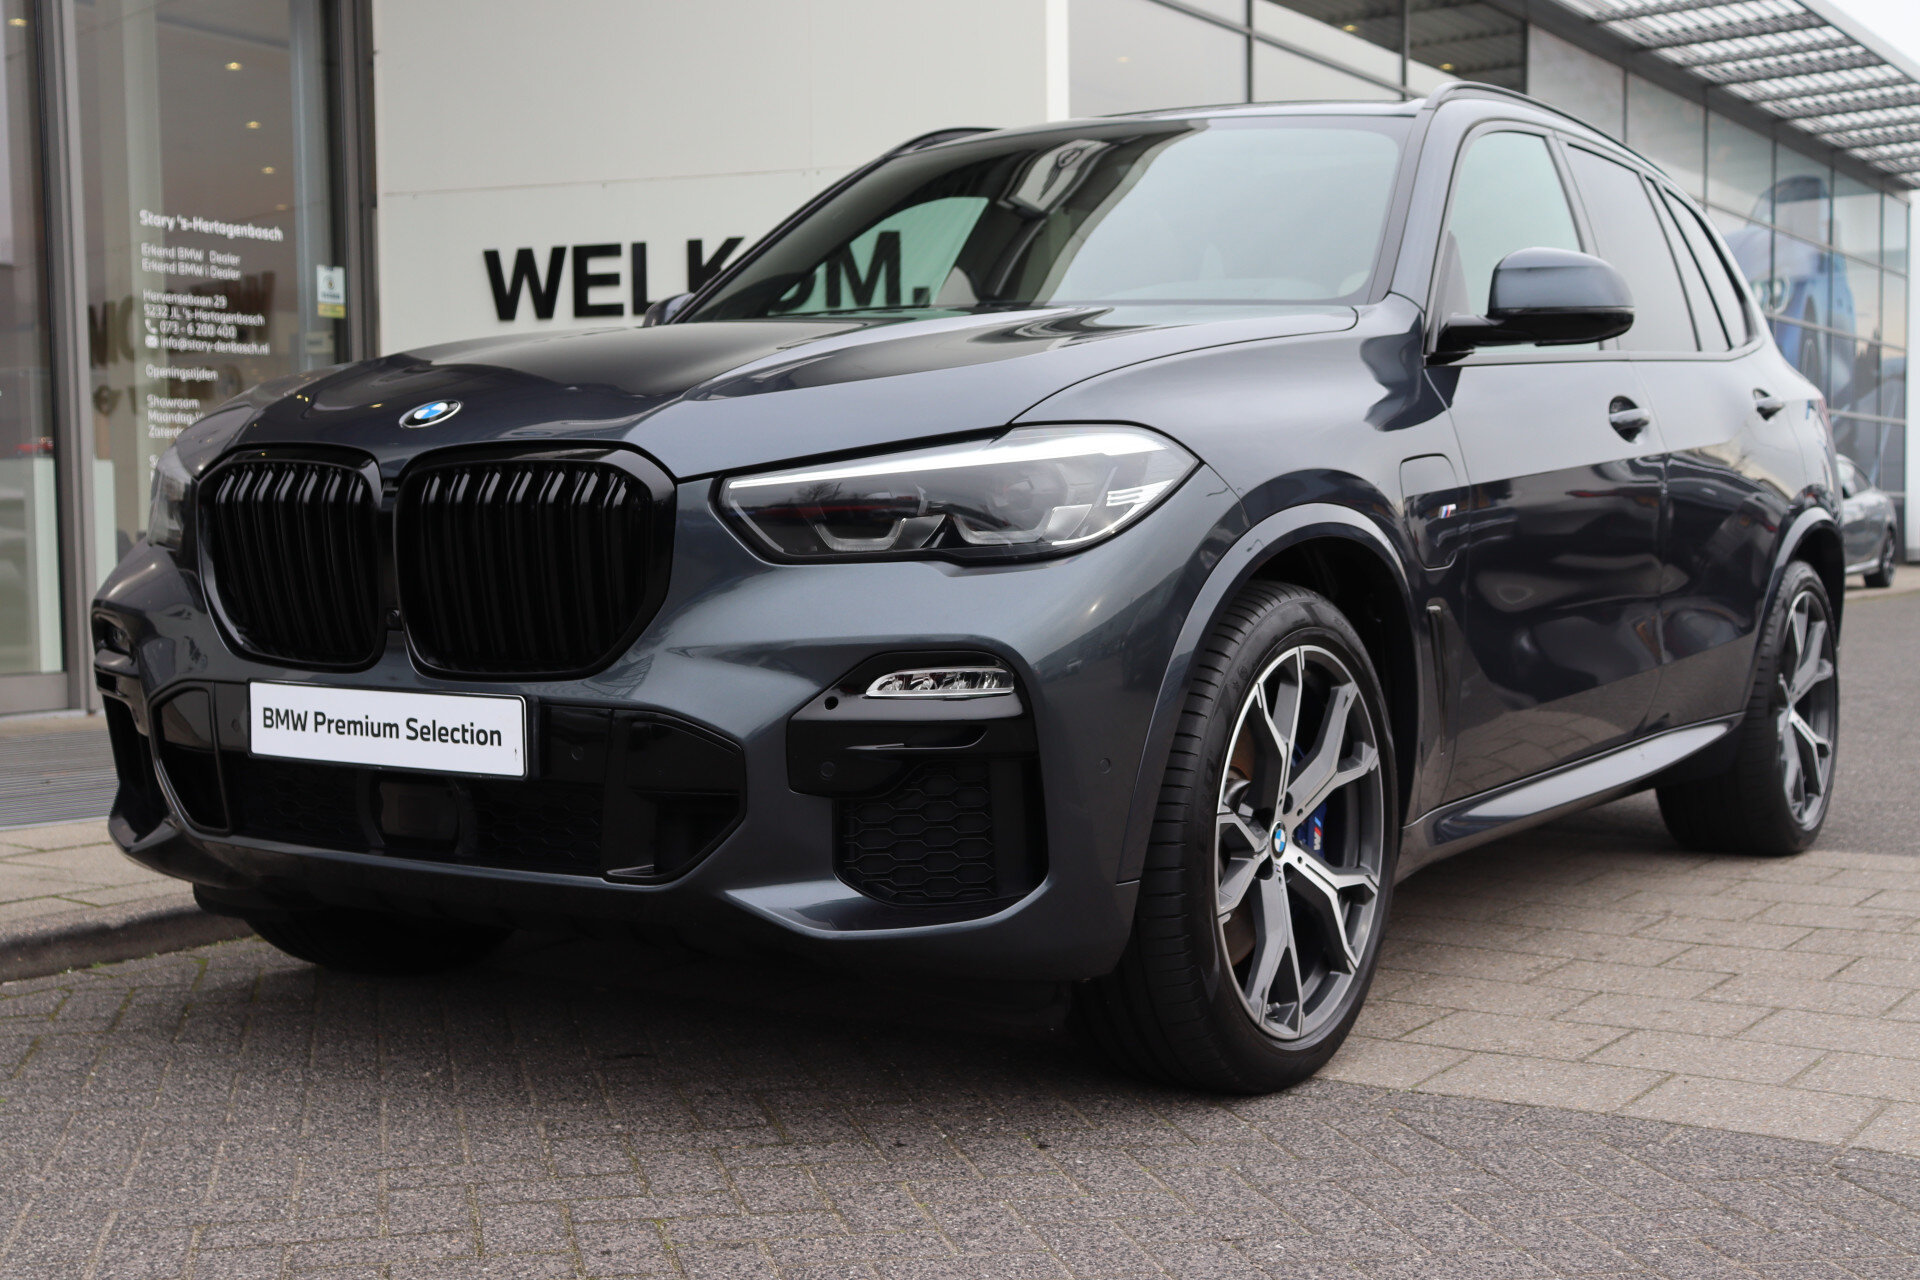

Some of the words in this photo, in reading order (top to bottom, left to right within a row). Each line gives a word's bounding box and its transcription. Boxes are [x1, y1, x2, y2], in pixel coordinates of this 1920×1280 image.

[139, 209, 175, 232] Story
[141, 242, 176, 259] Erkend
[177, 246, 204, 261] BMW
[209, 250, 241, 266] Dealer
[141, 257, 177, 274] Erkend
[177, 262, 204, 277] BMW
[209, 265, 242, 281] Dealer
[482, 230, 931, 322] WELKM.
[213, 294, 228, 309] 29
[159, 319, 180, 335] 073
[187, 321, 195, 336] 6
[195, 322, 216, 338] 200
[216, 324, 238, 340] 400
[145, 363, 219, 382] Openingstijden
[146, 393, 200, 409] Showroom
[262, 706, 308, 732] BMW
[313, 710, 400, 740] Premium
[405, 716, 503, 747] Selection
